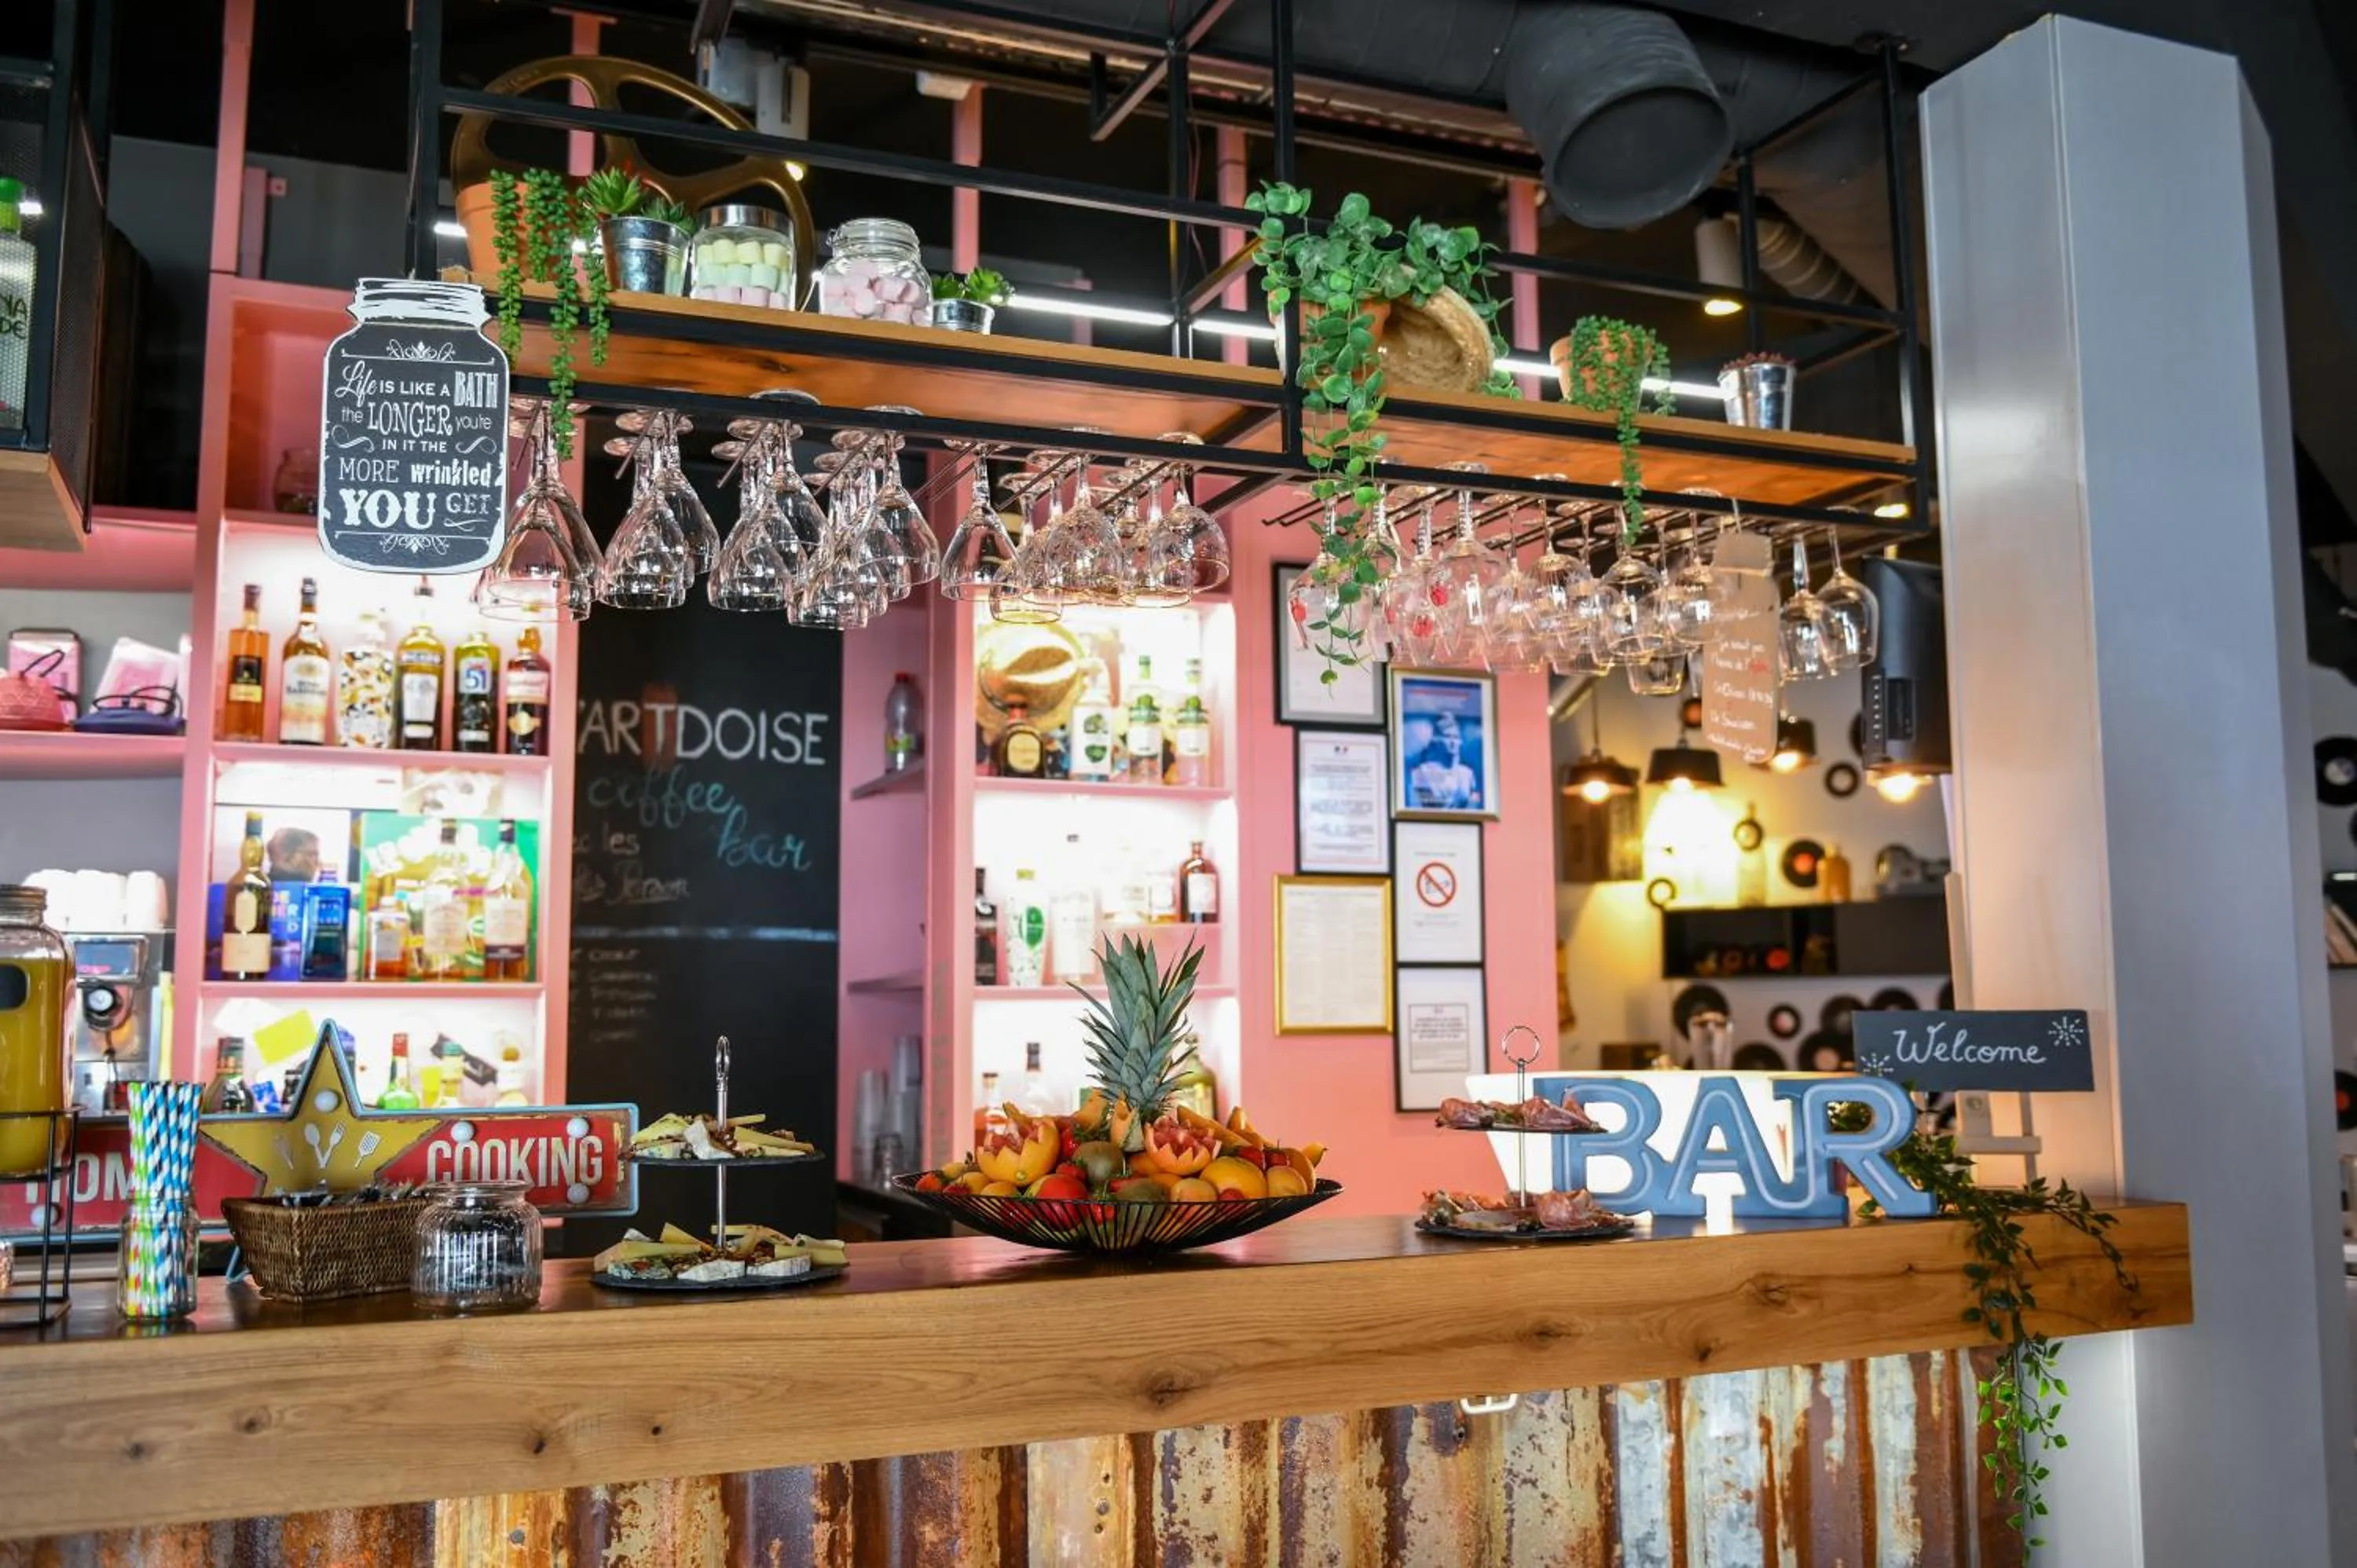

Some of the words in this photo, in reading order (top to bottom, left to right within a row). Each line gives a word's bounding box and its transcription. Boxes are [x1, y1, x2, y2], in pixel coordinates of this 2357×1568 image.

[335, 361, 377, 408] Life
[379, 379, 394, 394] IS
[400, 381, 435, 397] LIKE
[439, 384, 450, 397] A
[453, 370, 498, 409] BATH
[342, 406, 363, 423] the
[367, 401, 453, 438] LONGER
[382, 440, 397, 451] IN
[403, 440, 416, 452] IT
[420, 441, 447, 453] THE
[339, 456, 400, 483] MORE
[411, 458, 491, 487] wrinkled
[339, 488, 437, 530] YOU
[445, 492, 491, 515] GET
[465, 669, 486, 690] 51
[586, 764, 735, 829] coffee
[717, 804, 812, 871] bar
[1892, 1021, 2047, 1064] Welcome
[427, 1135, 603, 1187] COOKING
[1534, 1076, 1939, 1219] BAR
